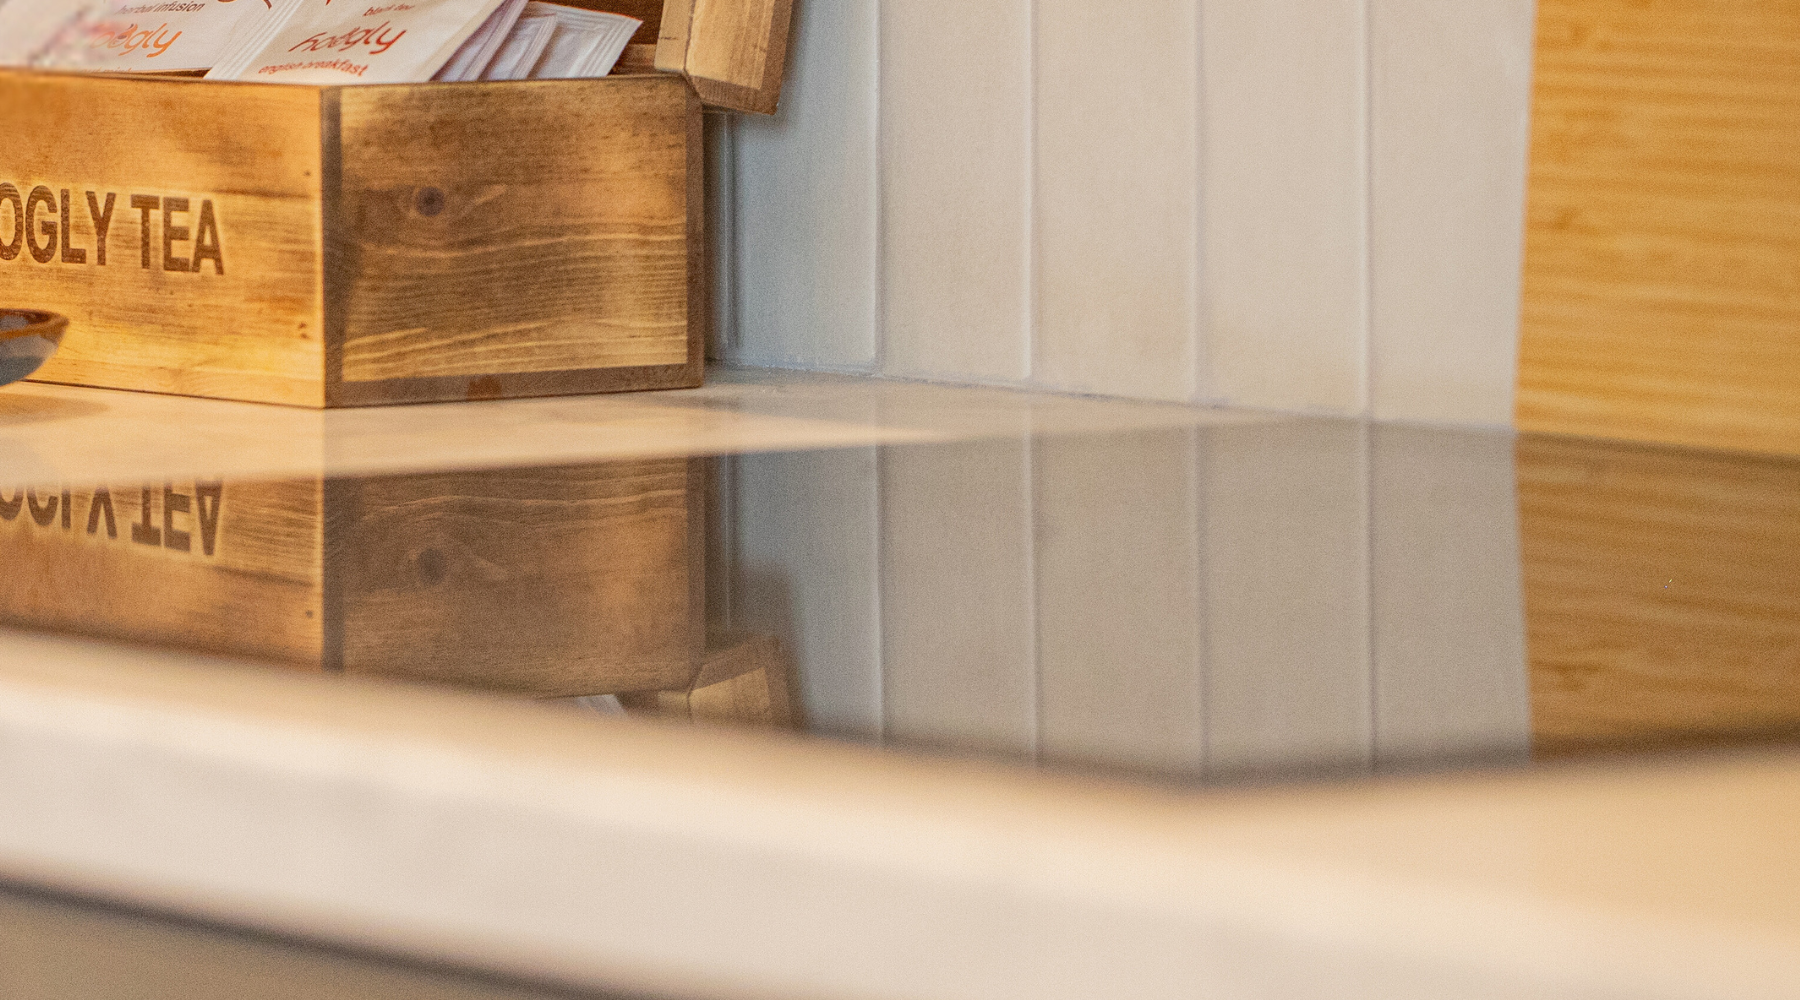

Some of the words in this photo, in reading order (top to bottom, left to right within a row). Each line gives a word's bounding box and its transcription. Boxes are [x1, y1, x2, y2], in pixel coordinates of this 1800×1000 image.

[154, 1, 205, 12] infusion
[288, 20, 407, 55] hoogly
[302, 58, 368, 77] breakfast
[130, 194, 225, 275] TEA
